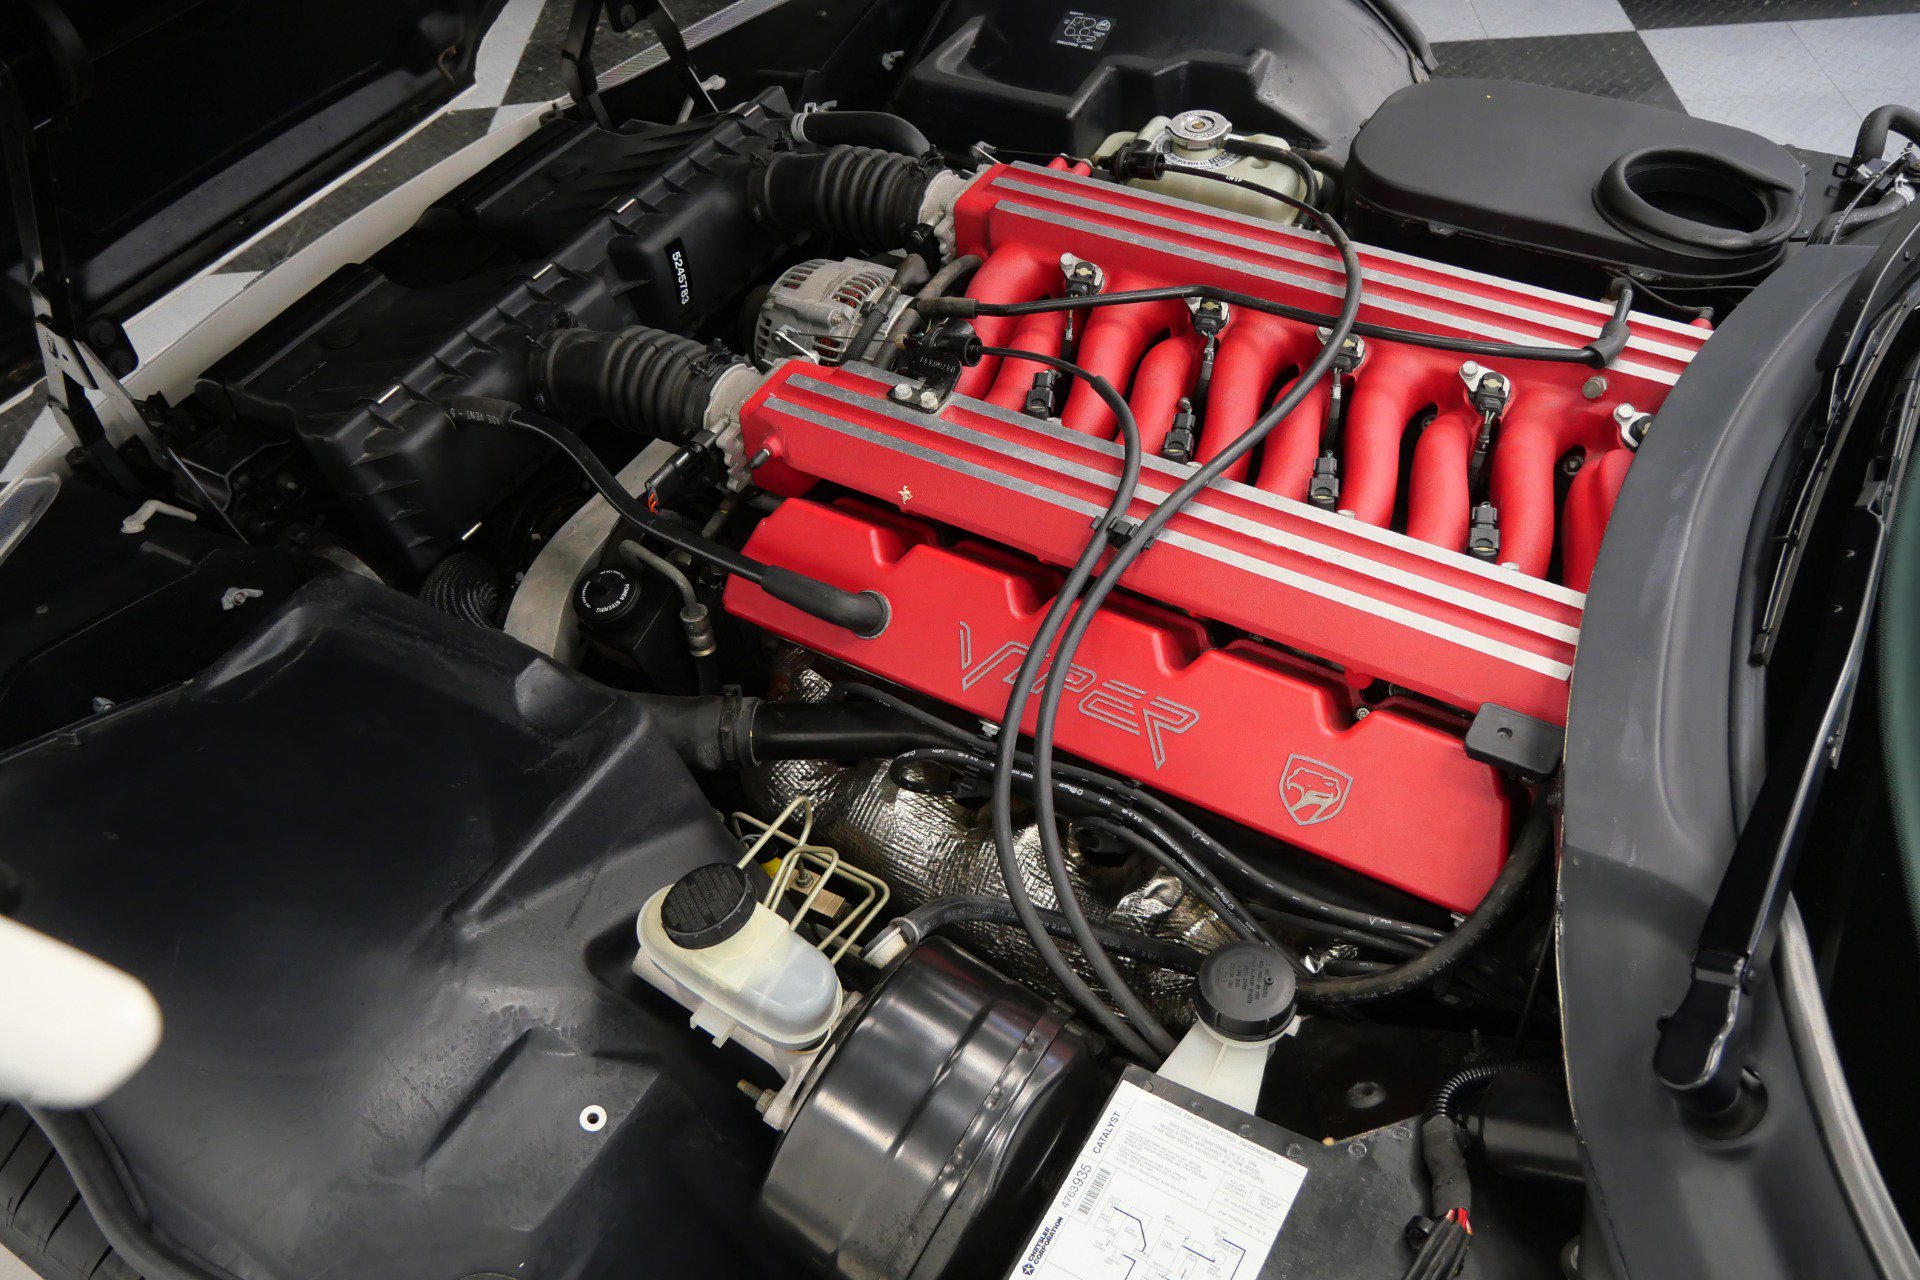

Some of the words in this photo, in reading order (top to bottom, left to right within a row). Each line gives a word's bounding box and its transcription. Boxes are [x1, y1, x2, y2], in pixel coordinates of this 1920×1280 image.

[671, 250, 689, 305] 5245783
[464, 409, 485, 422] VENT
[595, 599, 621, 613] STEERING
[619, 583, 629, 600] POWER
[1181, 853, 1206, 878] ELECTRONIC
[1213, 886, 1230, 905] Mopar
[1092, 1111, 1121, 1155] CATALYST
[1159, 1102, 1183, 1116] VEHICLE
[1182, 1113, 1210, 1130] EMISSION
[1210, 1126, 1238, 1143] CONTROL
[1237, 1138, 1278, 1164] INFORMATION
[1061, 1163, 1092, 1209] 4763935
[1028, 1226, 1051, 1263] CHRYSLER
[1033, 1216, 1064, 1265] CORPORATION
